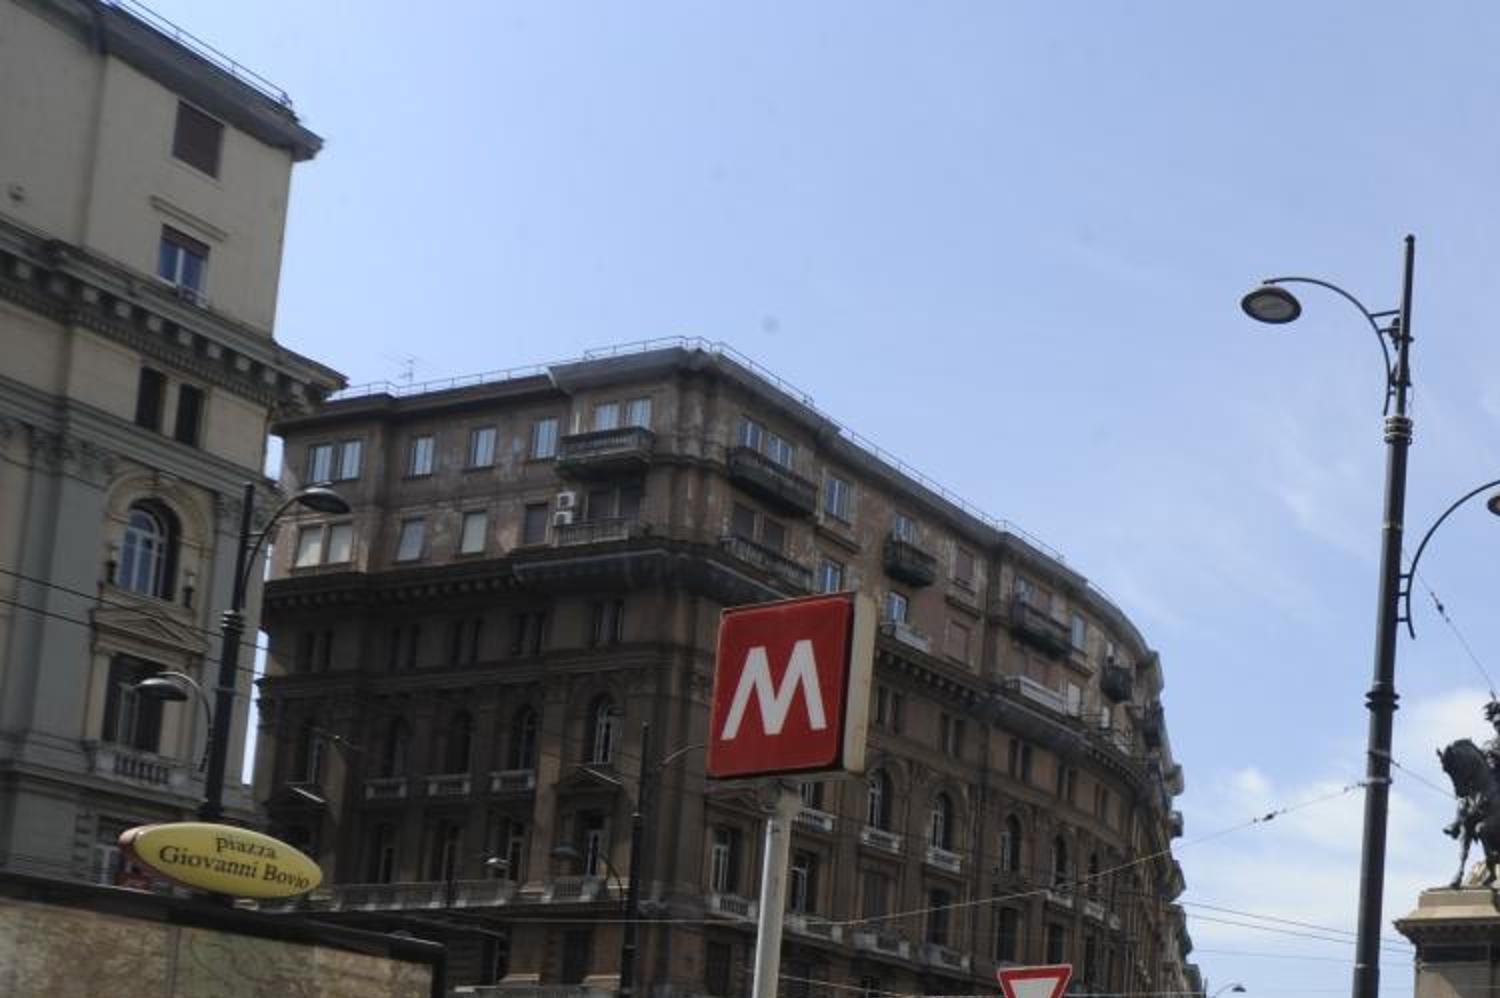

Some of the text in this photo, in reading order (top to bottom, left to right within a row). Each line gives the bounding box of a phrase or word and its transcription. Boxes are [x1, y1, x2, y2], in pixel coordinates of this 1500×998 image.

[720, 639, 828, 741] M
[159, 844, 310, 889] Giovanni Bovio
[215, 836, 277, 859] piazza
